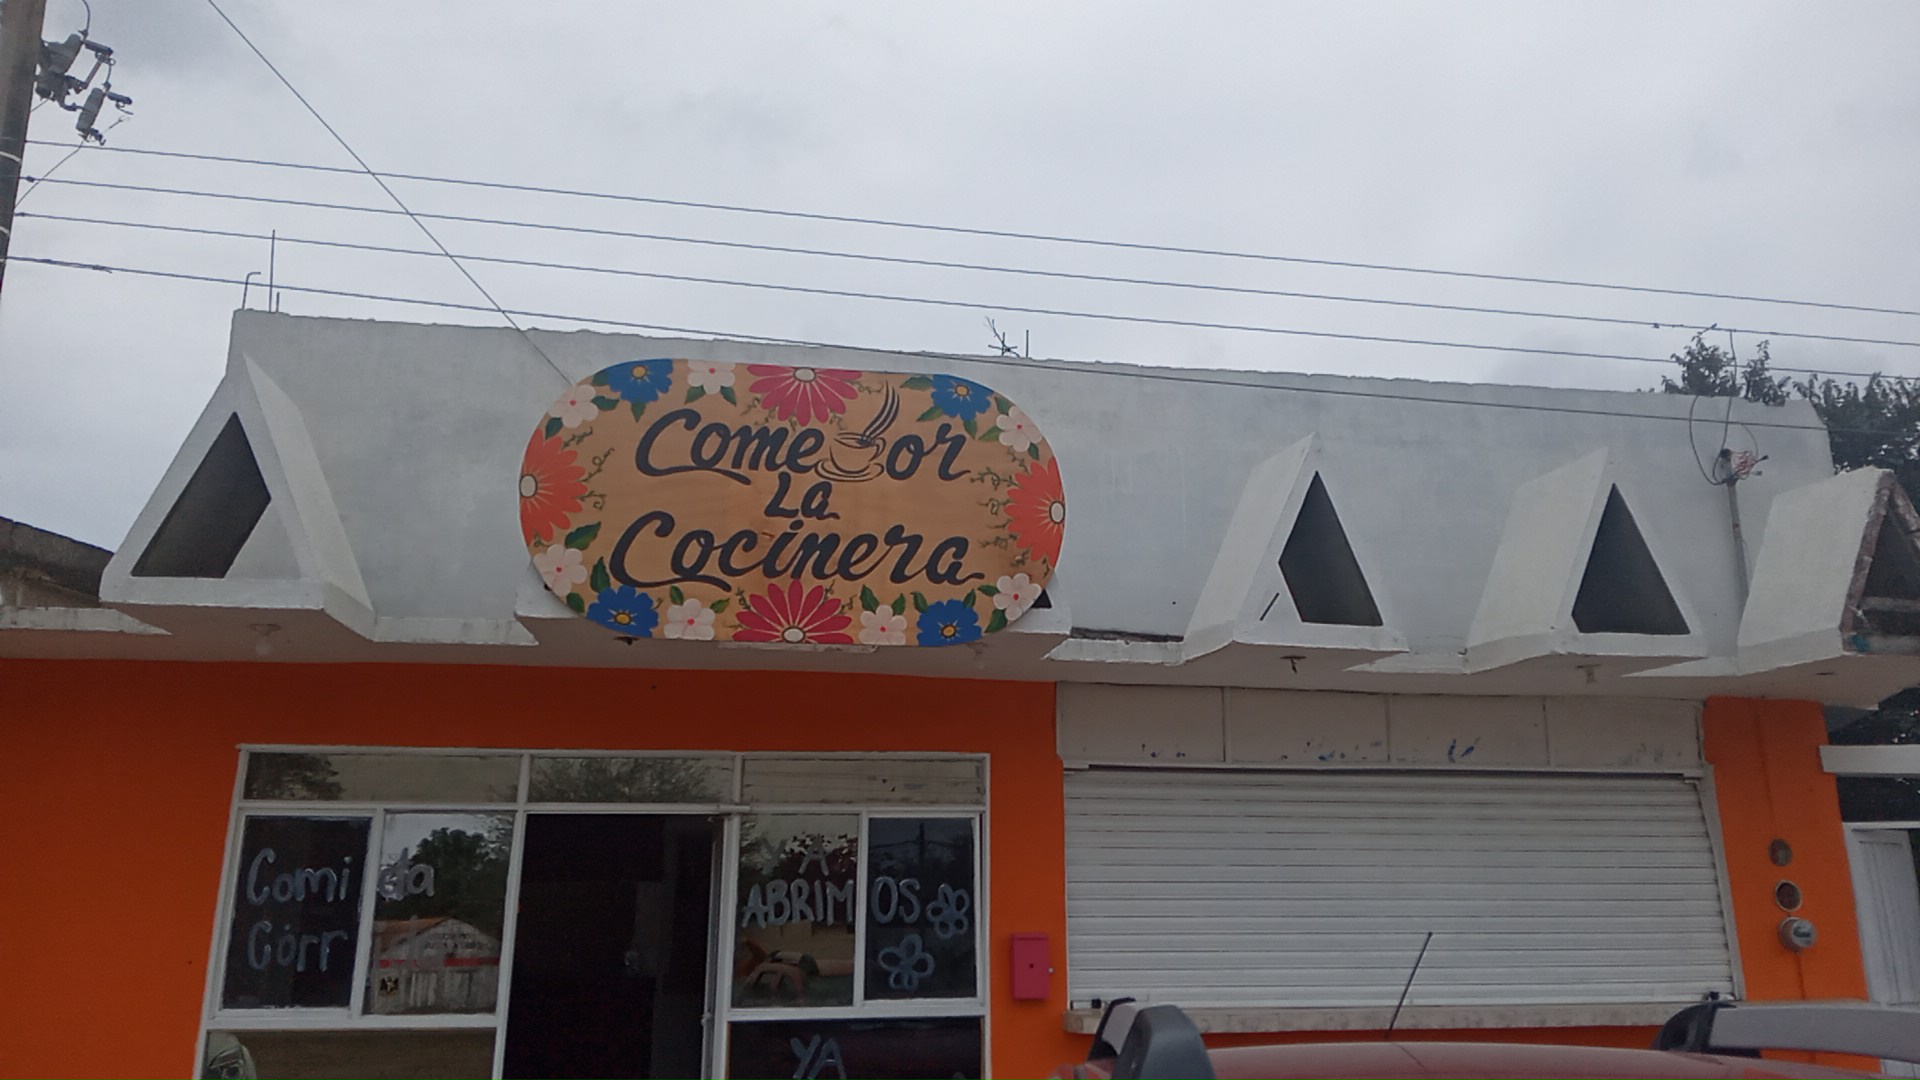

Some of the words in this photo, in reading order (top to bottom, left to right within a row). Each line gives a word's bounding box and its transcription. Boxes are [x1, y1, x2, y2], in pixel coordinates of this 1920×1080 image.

[763, 471, 840, 521] La
[608, 510, 985, 593] Cocinera
[790, 1033, 848, 1080] YA
